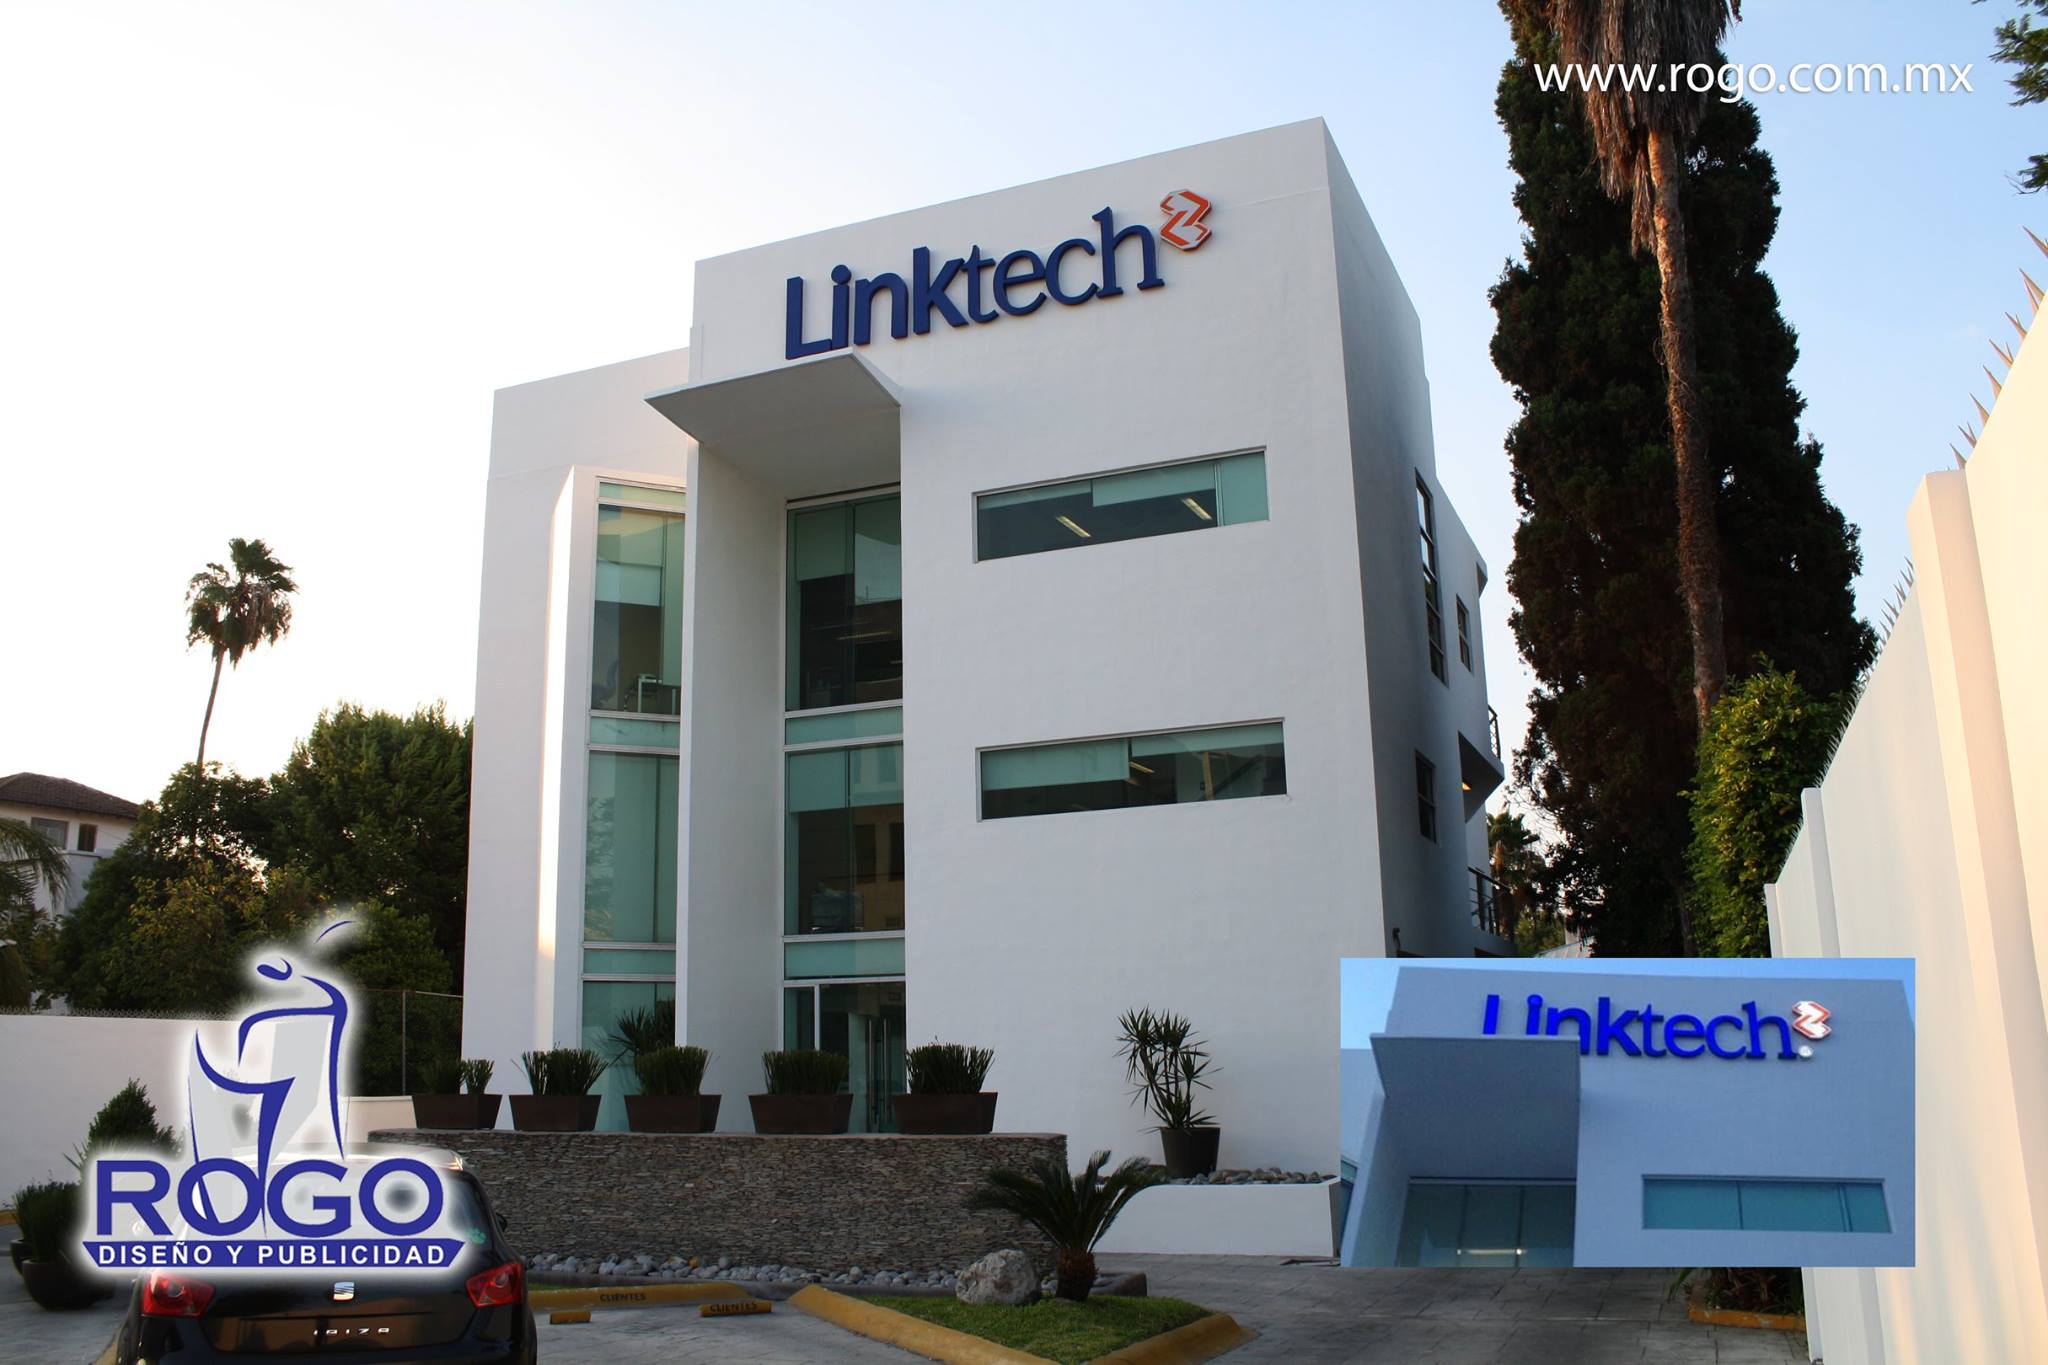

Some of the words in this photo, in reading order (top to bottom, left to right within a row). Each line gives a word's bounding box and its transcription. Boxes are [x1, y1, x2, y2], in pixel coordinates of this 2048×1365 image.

[785, 206, 1166, 360] Linktech
[600, 1293, 647, 1302] CLIENTES
[710, 1302, 758, 1313] CLIENTES
